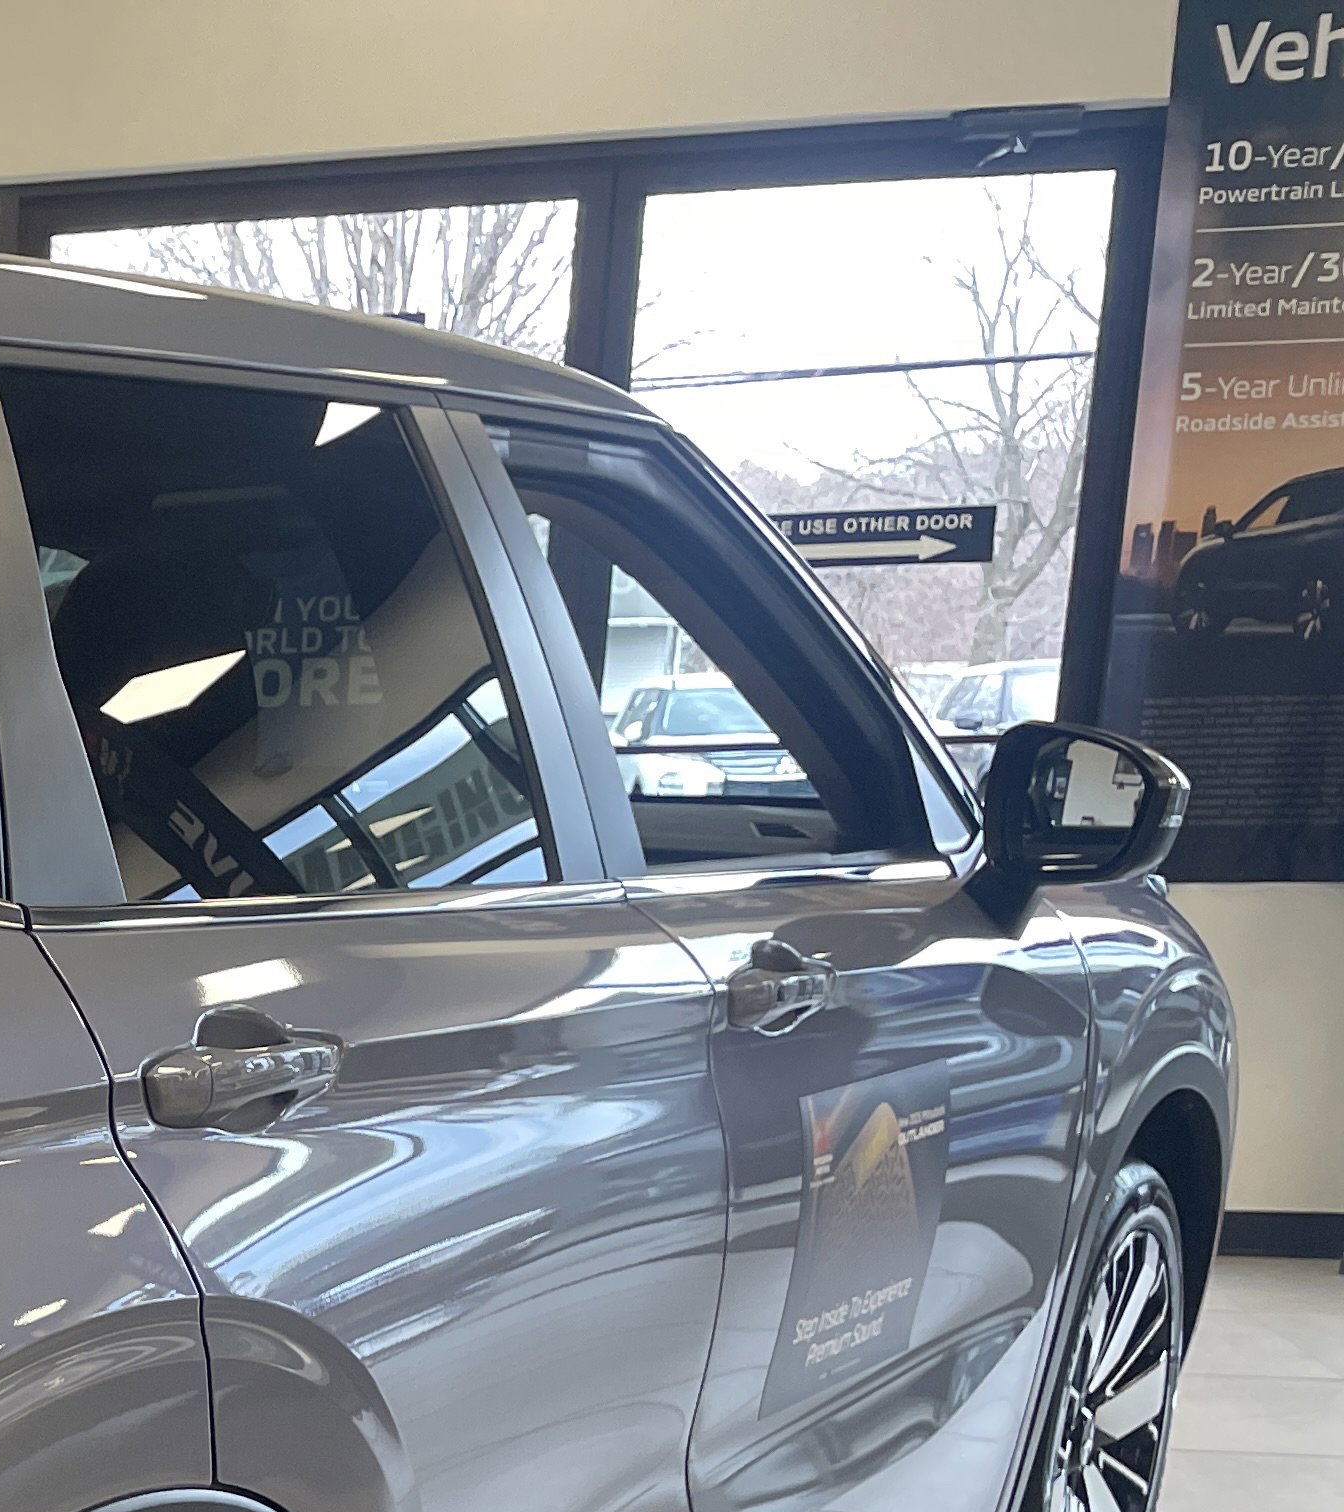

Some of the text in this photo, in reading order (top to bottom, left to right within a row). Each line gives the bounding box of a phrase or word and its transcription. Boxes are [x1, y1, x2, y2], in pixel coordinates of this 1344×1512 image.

[1198, 180, 1323, 205] Powertrain
[1187, 298, 1272, 320] Limited
[1180, 371, 1281, 402] 5-Year
[1174, 411, 1277, 434] Roadside
[798, 519, 837, 535] USE
[843, 515, 910, 534] OTHER
[915, 513, 973, 531] DOOR
